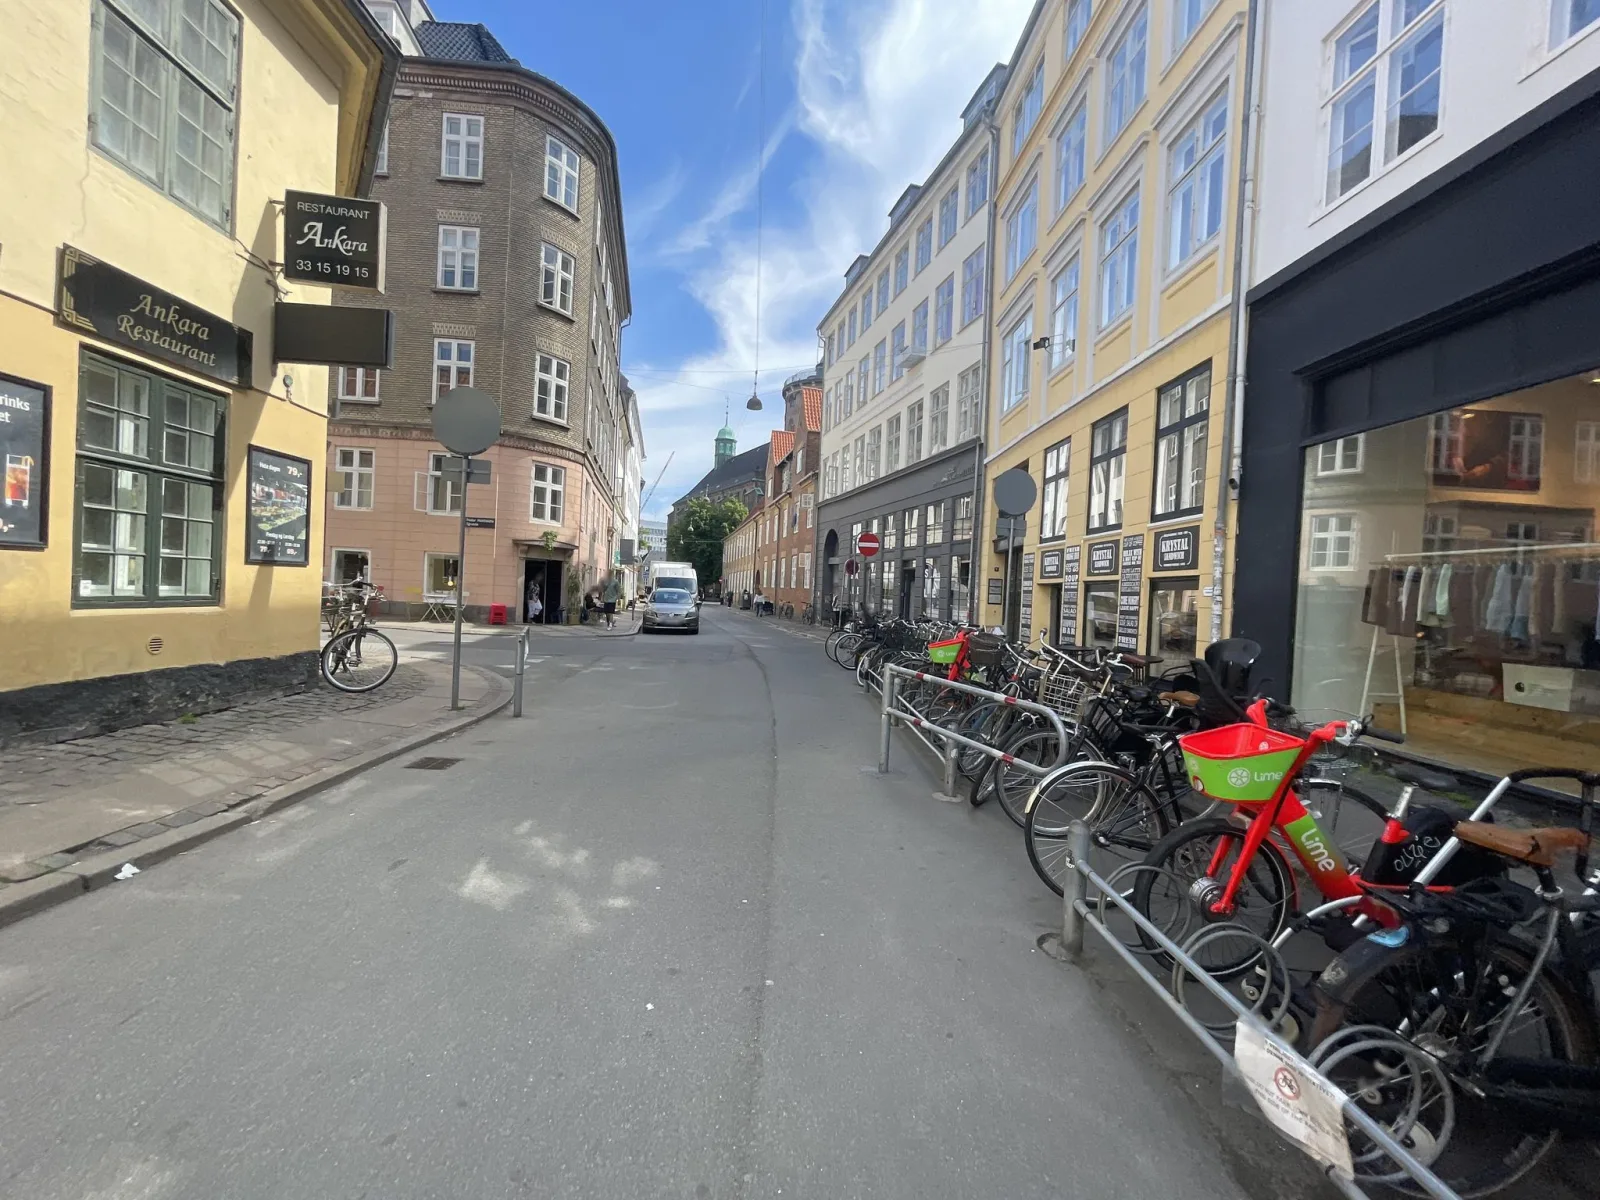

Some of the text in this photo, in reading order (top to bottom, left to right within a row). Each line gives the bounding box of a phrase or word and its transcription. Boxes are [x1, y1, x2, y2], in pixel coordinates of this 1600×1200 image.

[297, 202, 370, 220] RESTAURANT
[296, 222, 368, 256] Ankara
[296, 260, 369, 278] 33 15 19 15
[130, 294, 210, 340] Ankara
[116, 314, 216, 366] Restaurant
[286, 466, 302, 478] 79,-
[1162, 538, 1188, 552] KRYSTAL
[1254, 770, 1284, 782] Lime
[1301, 828, 1336, 872] Lime
